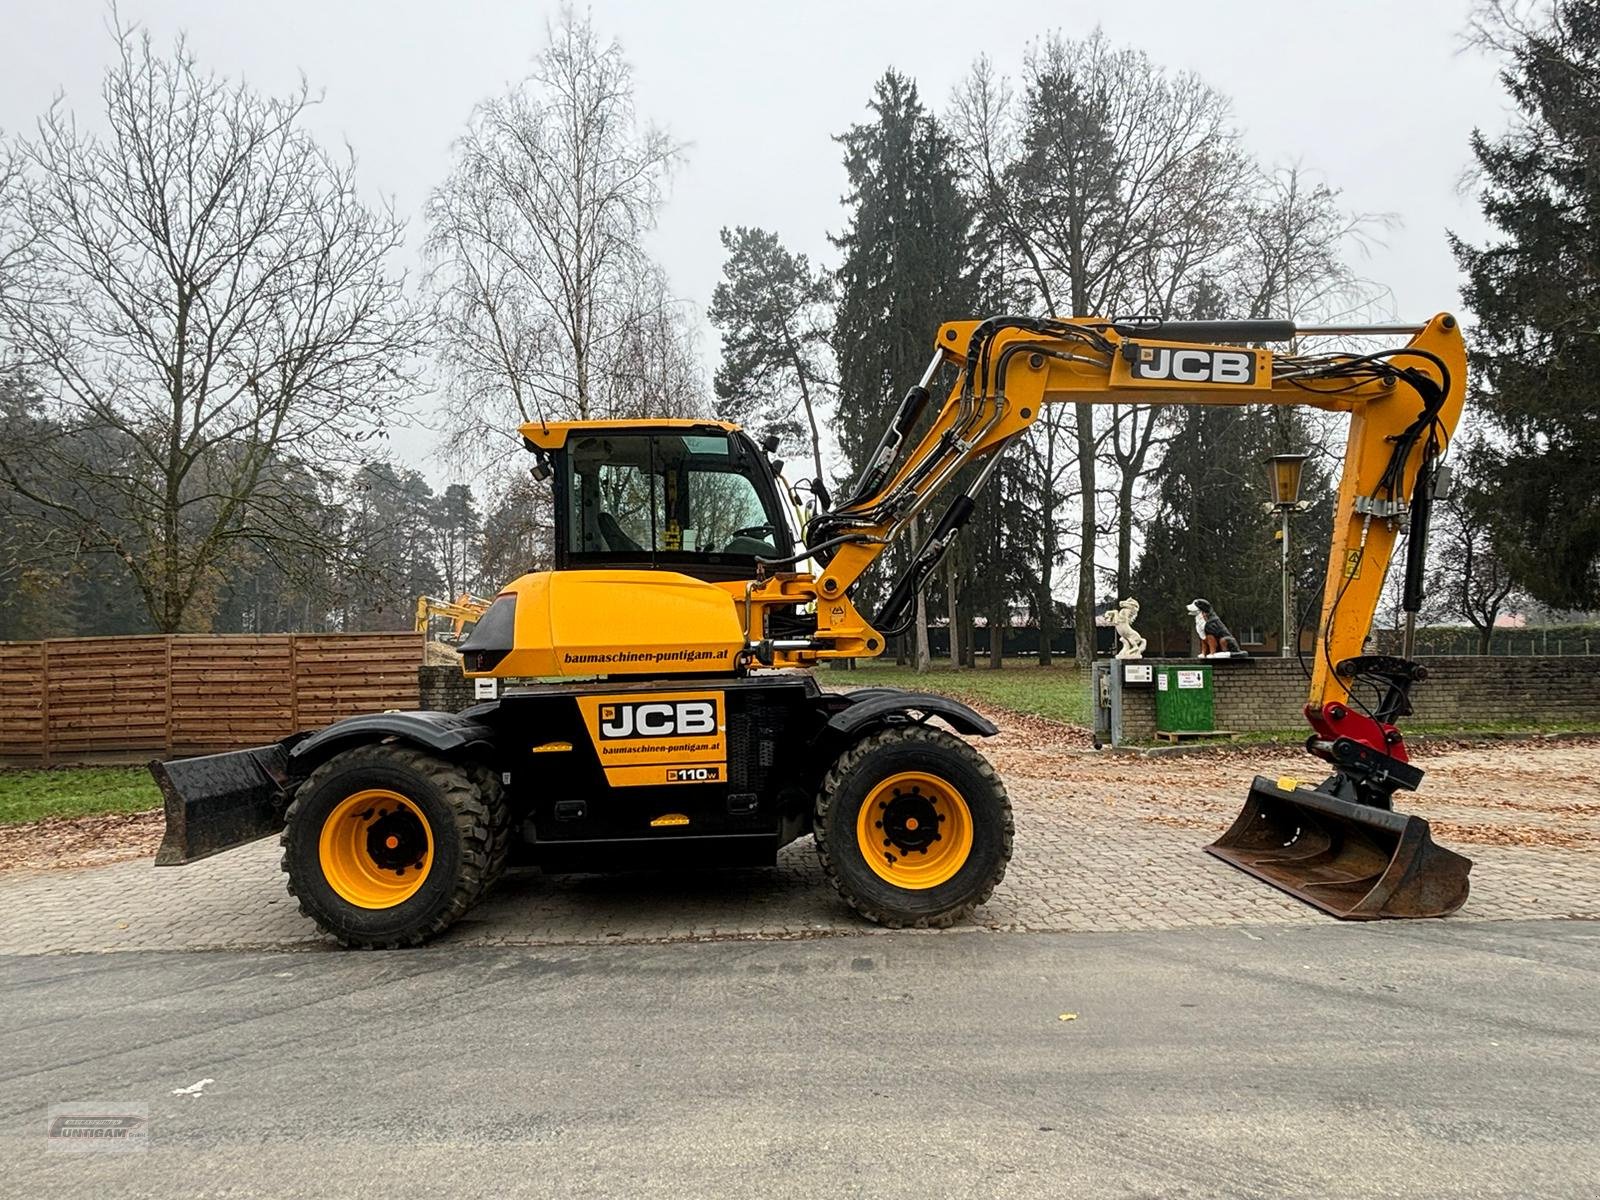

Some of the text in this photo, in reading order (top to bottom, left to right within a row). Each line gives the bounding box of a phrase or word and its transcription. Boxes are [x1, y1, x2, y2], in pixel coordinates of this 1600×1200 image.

[1140, 349, 1250, 383] JCB
[564, 649, 729, 664] baumaschinen-puntigam.at
[602, 702, 715, 738] JCB
[602, 742, 720, 755] baumaschinen-puntigam.at
